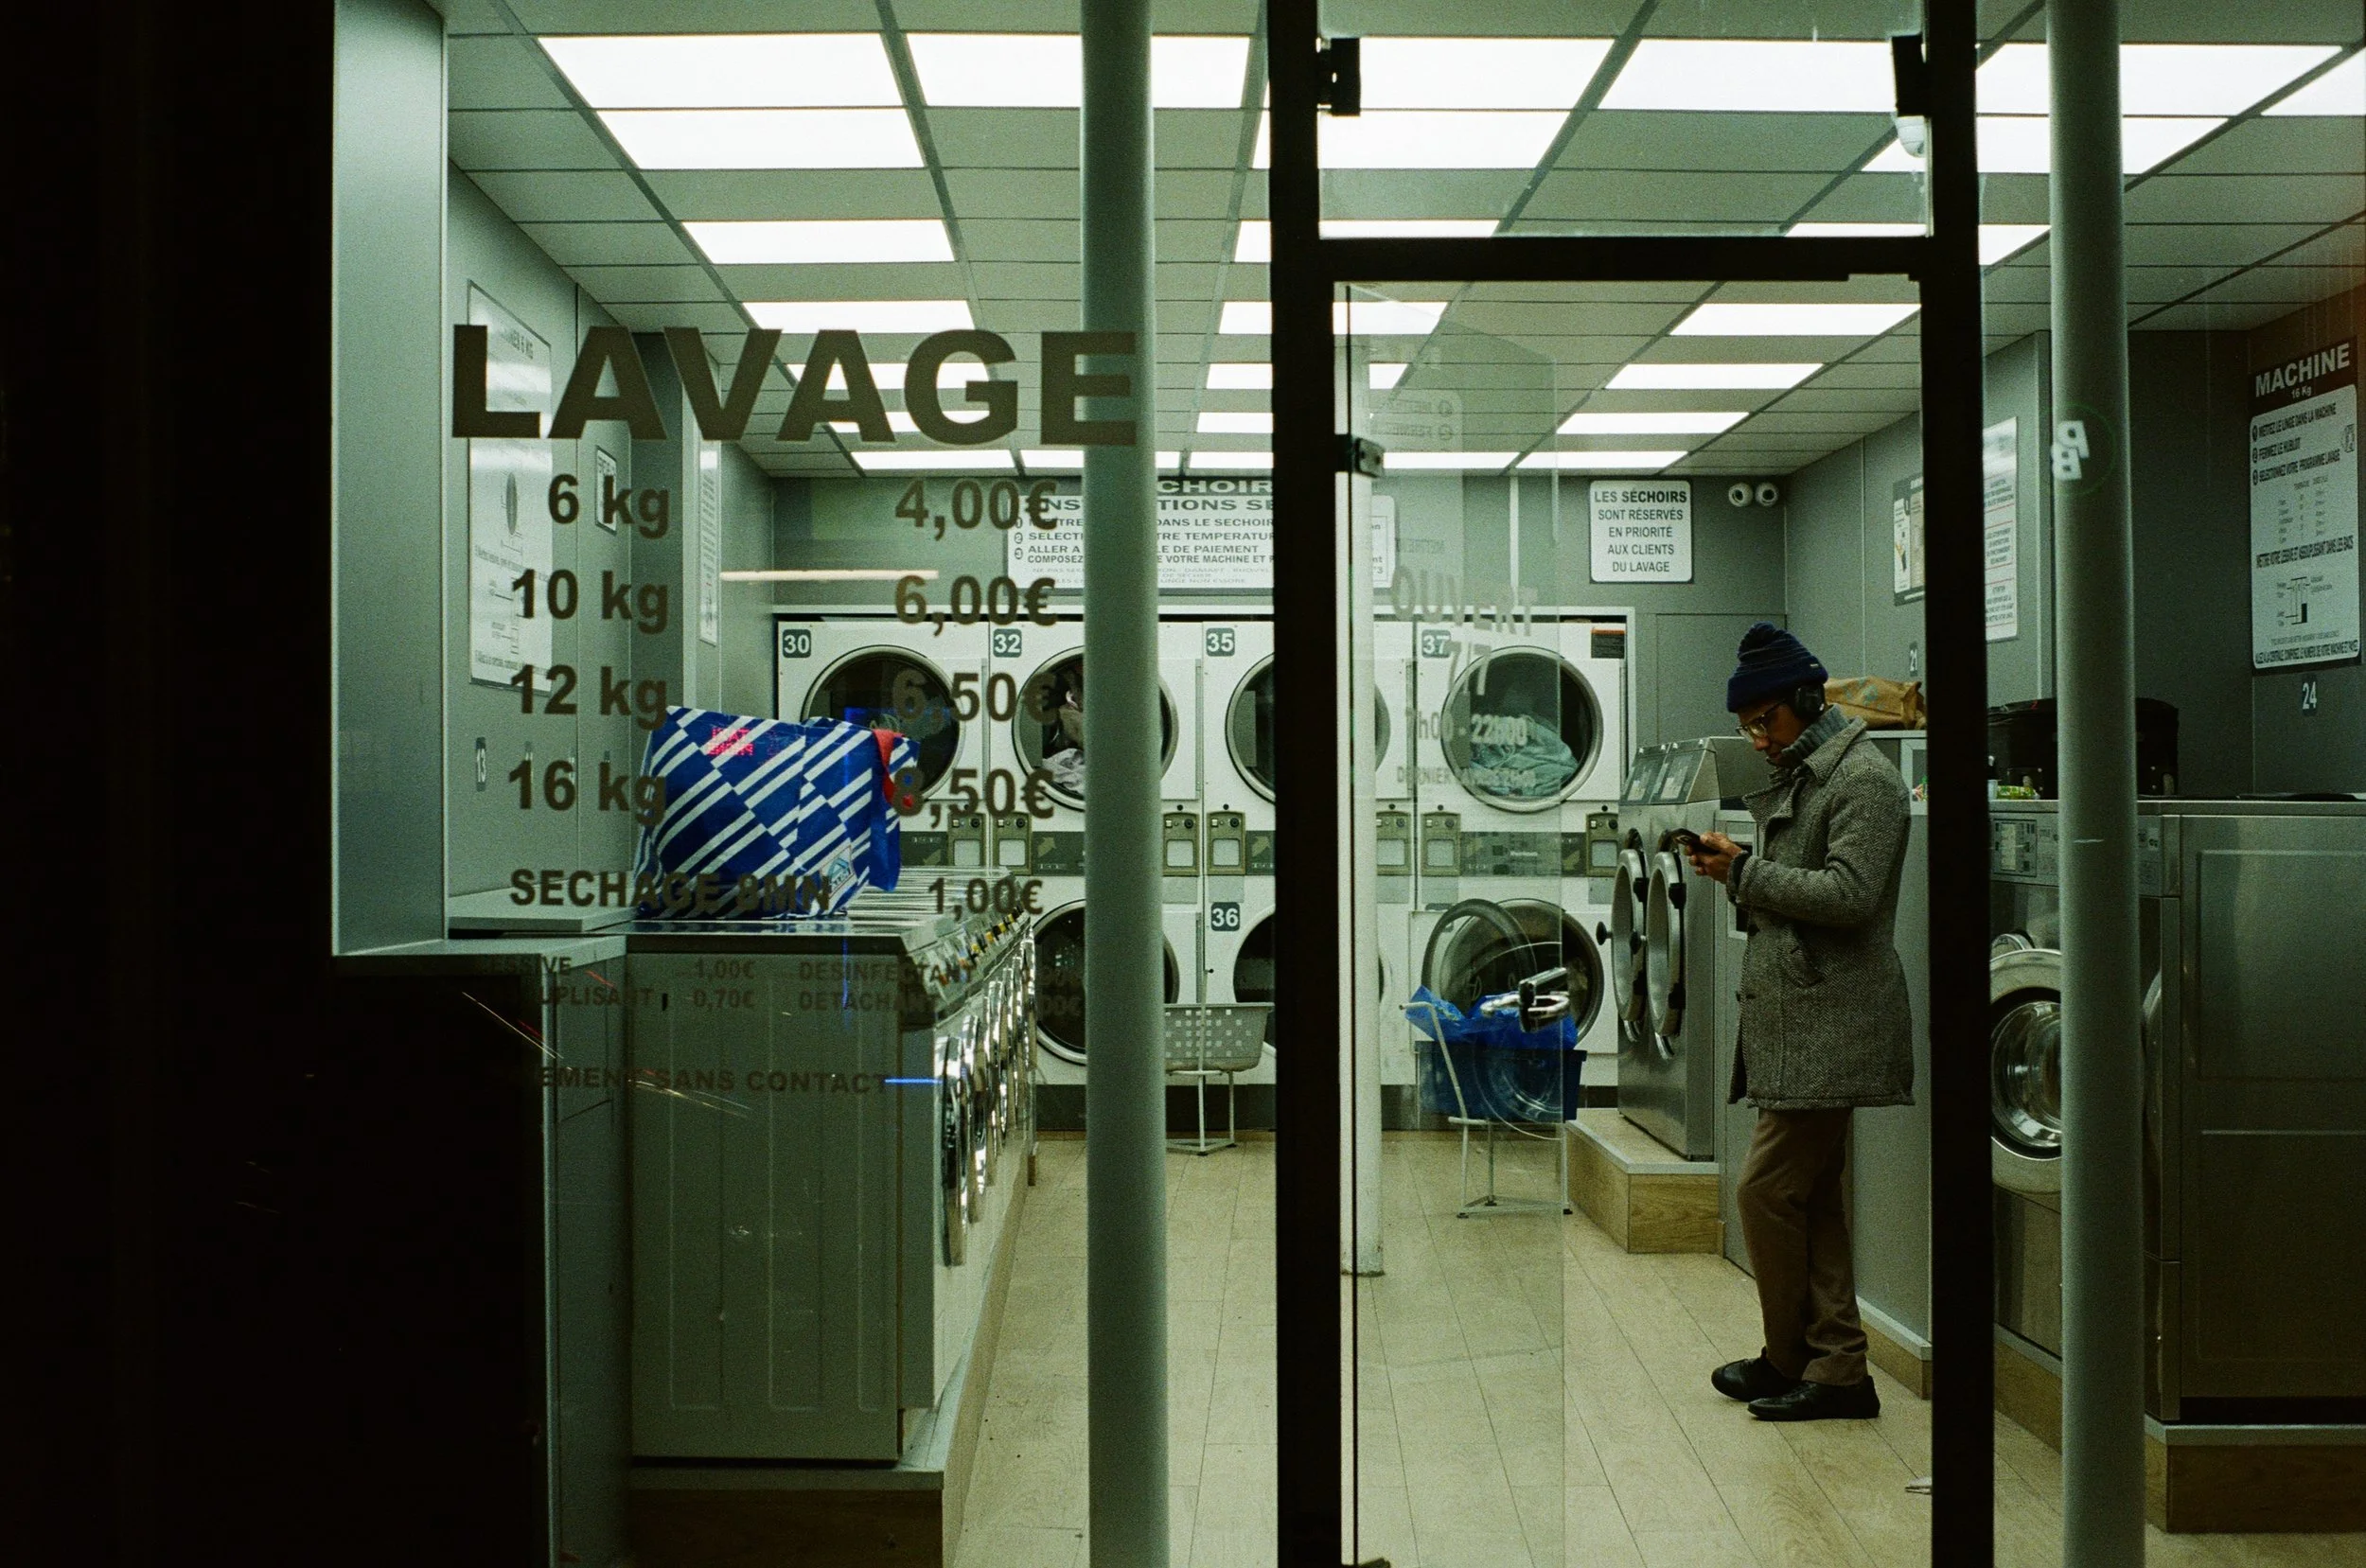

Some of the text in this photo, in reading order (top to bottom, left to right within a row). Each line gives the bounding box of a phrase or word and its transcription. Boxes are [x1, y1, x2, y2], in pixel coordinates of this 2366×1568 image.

[2255, 343, 2351, 398] MACHINE
[451, 324, 1139, 447] LAVAGE
[1157, 480, 1273, 493] CHOIR
[1594, 488, 1687, 504] LES SÉCHOIRS
[547, 474, 580, 525] 6
[603, 476, 669, 539] kg
[894, 479, 1058, 542] 4,00€
[1598, 508, 1626, 521] SONT
[1194, 518, 1210, 527] LE
[1609, 526, 1622, 538] EN
[1027, 555, 1084, 564] COMPOSEZ
[1165, 555, 1200, 564] VOTRE
[1202, 555, 1250, 563] MACHINE
[1253, 555, 1266, 563] ET
[1028, 545, 1068, 554] ALLER
[1071, 545, 1081, 554] A
[1173, 545, 1191, 554] DE
[1193, 545, 1260, 554] PAIEMENT
[1607, 543, 1674, 555] AUX CLIENTS
[1612, 561, 1670, 573] DU LAVAGE
[511, 569, 669, 634] 10 kg
[893, 574, 1058, 638] 6,00€
[785, 633, 809, 654] 30
[994, 633, 1020, 654] 32
[1208, 632, 1234, 652] 35
[1422, 635, 1450, 654] 37
[510, 664, 668, 731] 12 kg
[892, 669, 1058, 733] 6,50€
[2302, 681, 2318, 710] 24
[508, 760, 667, 826] 16 kg
[891, 766, 1055, 831] 8,50€
[509, 869, 726, 910] SECHAGE
[927, 879, 1045, 922] 1,00€
[1211, 908, 1239, 927] 36
[659, 1069, 734, 1091] SANS
[746, 1069, 889, 1094] CONTACT
